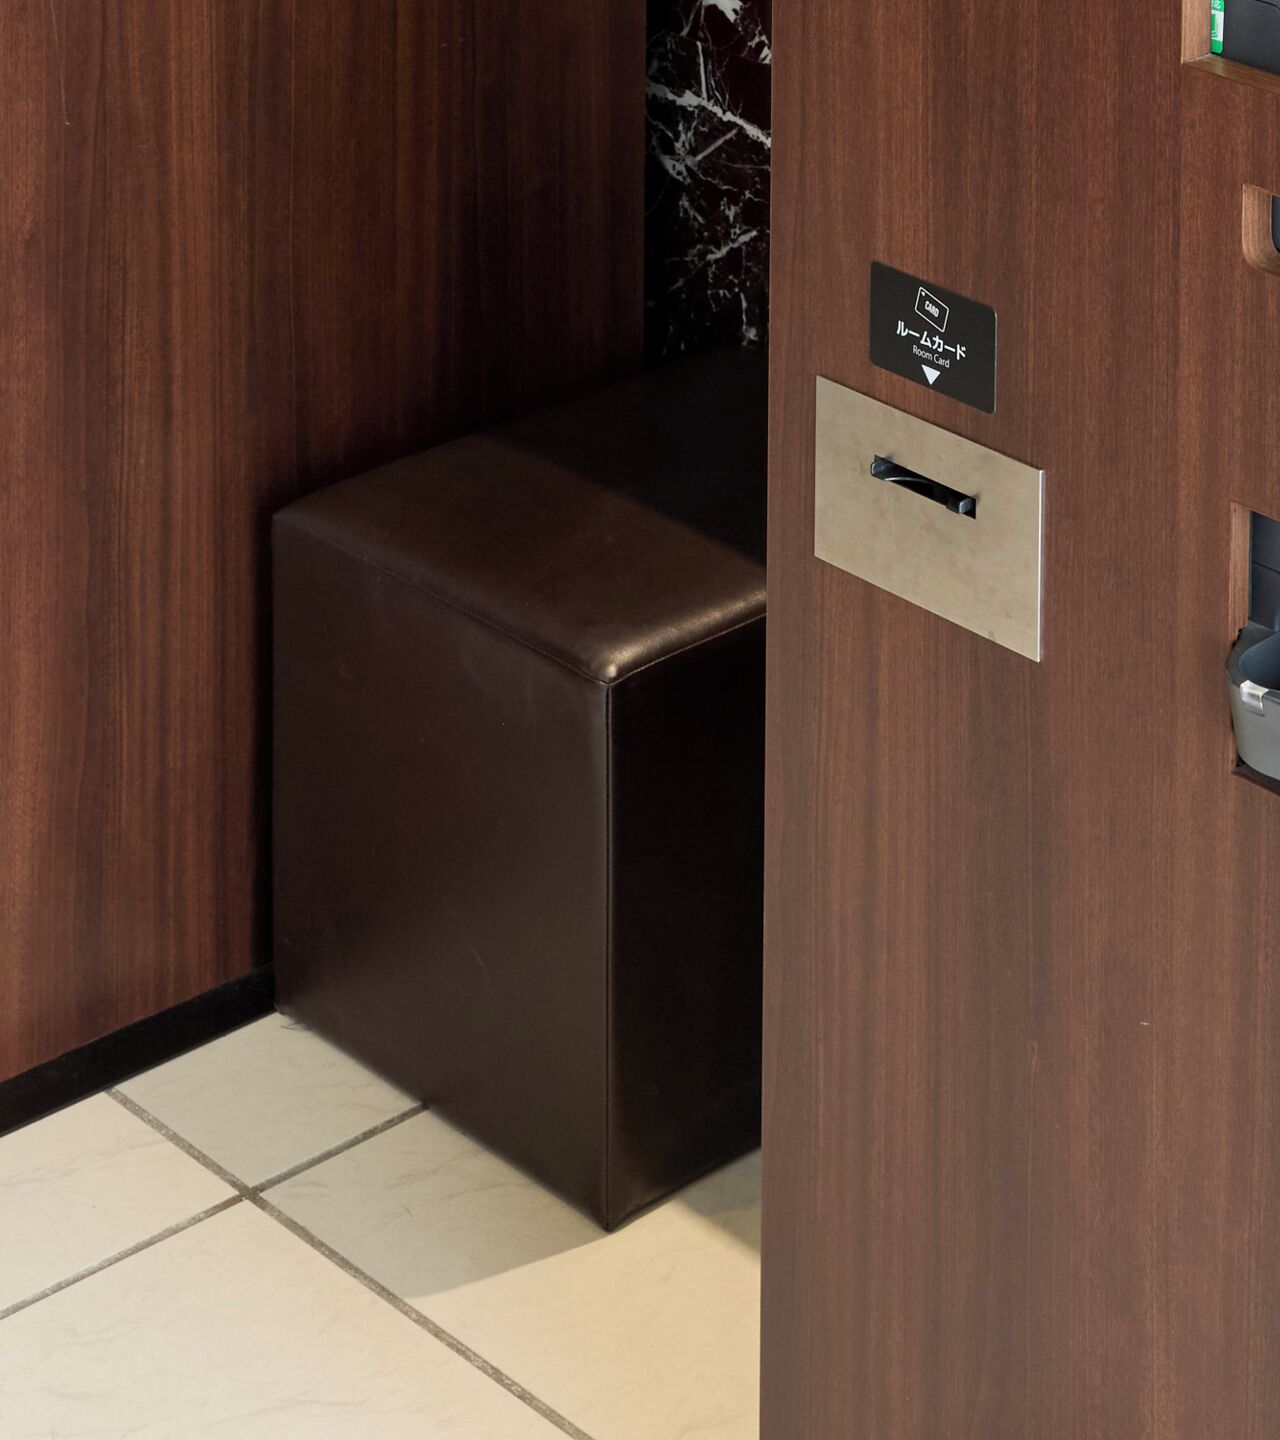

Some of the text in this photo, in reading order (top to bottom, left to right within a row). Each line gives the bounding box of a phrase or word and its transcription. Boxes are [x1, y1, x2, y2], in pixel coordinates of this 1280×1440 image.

[924, 300, 940, 318] CARD
[896, 320, 967, 361] ルームカード
[912, 344, 951, 368] Room Card
